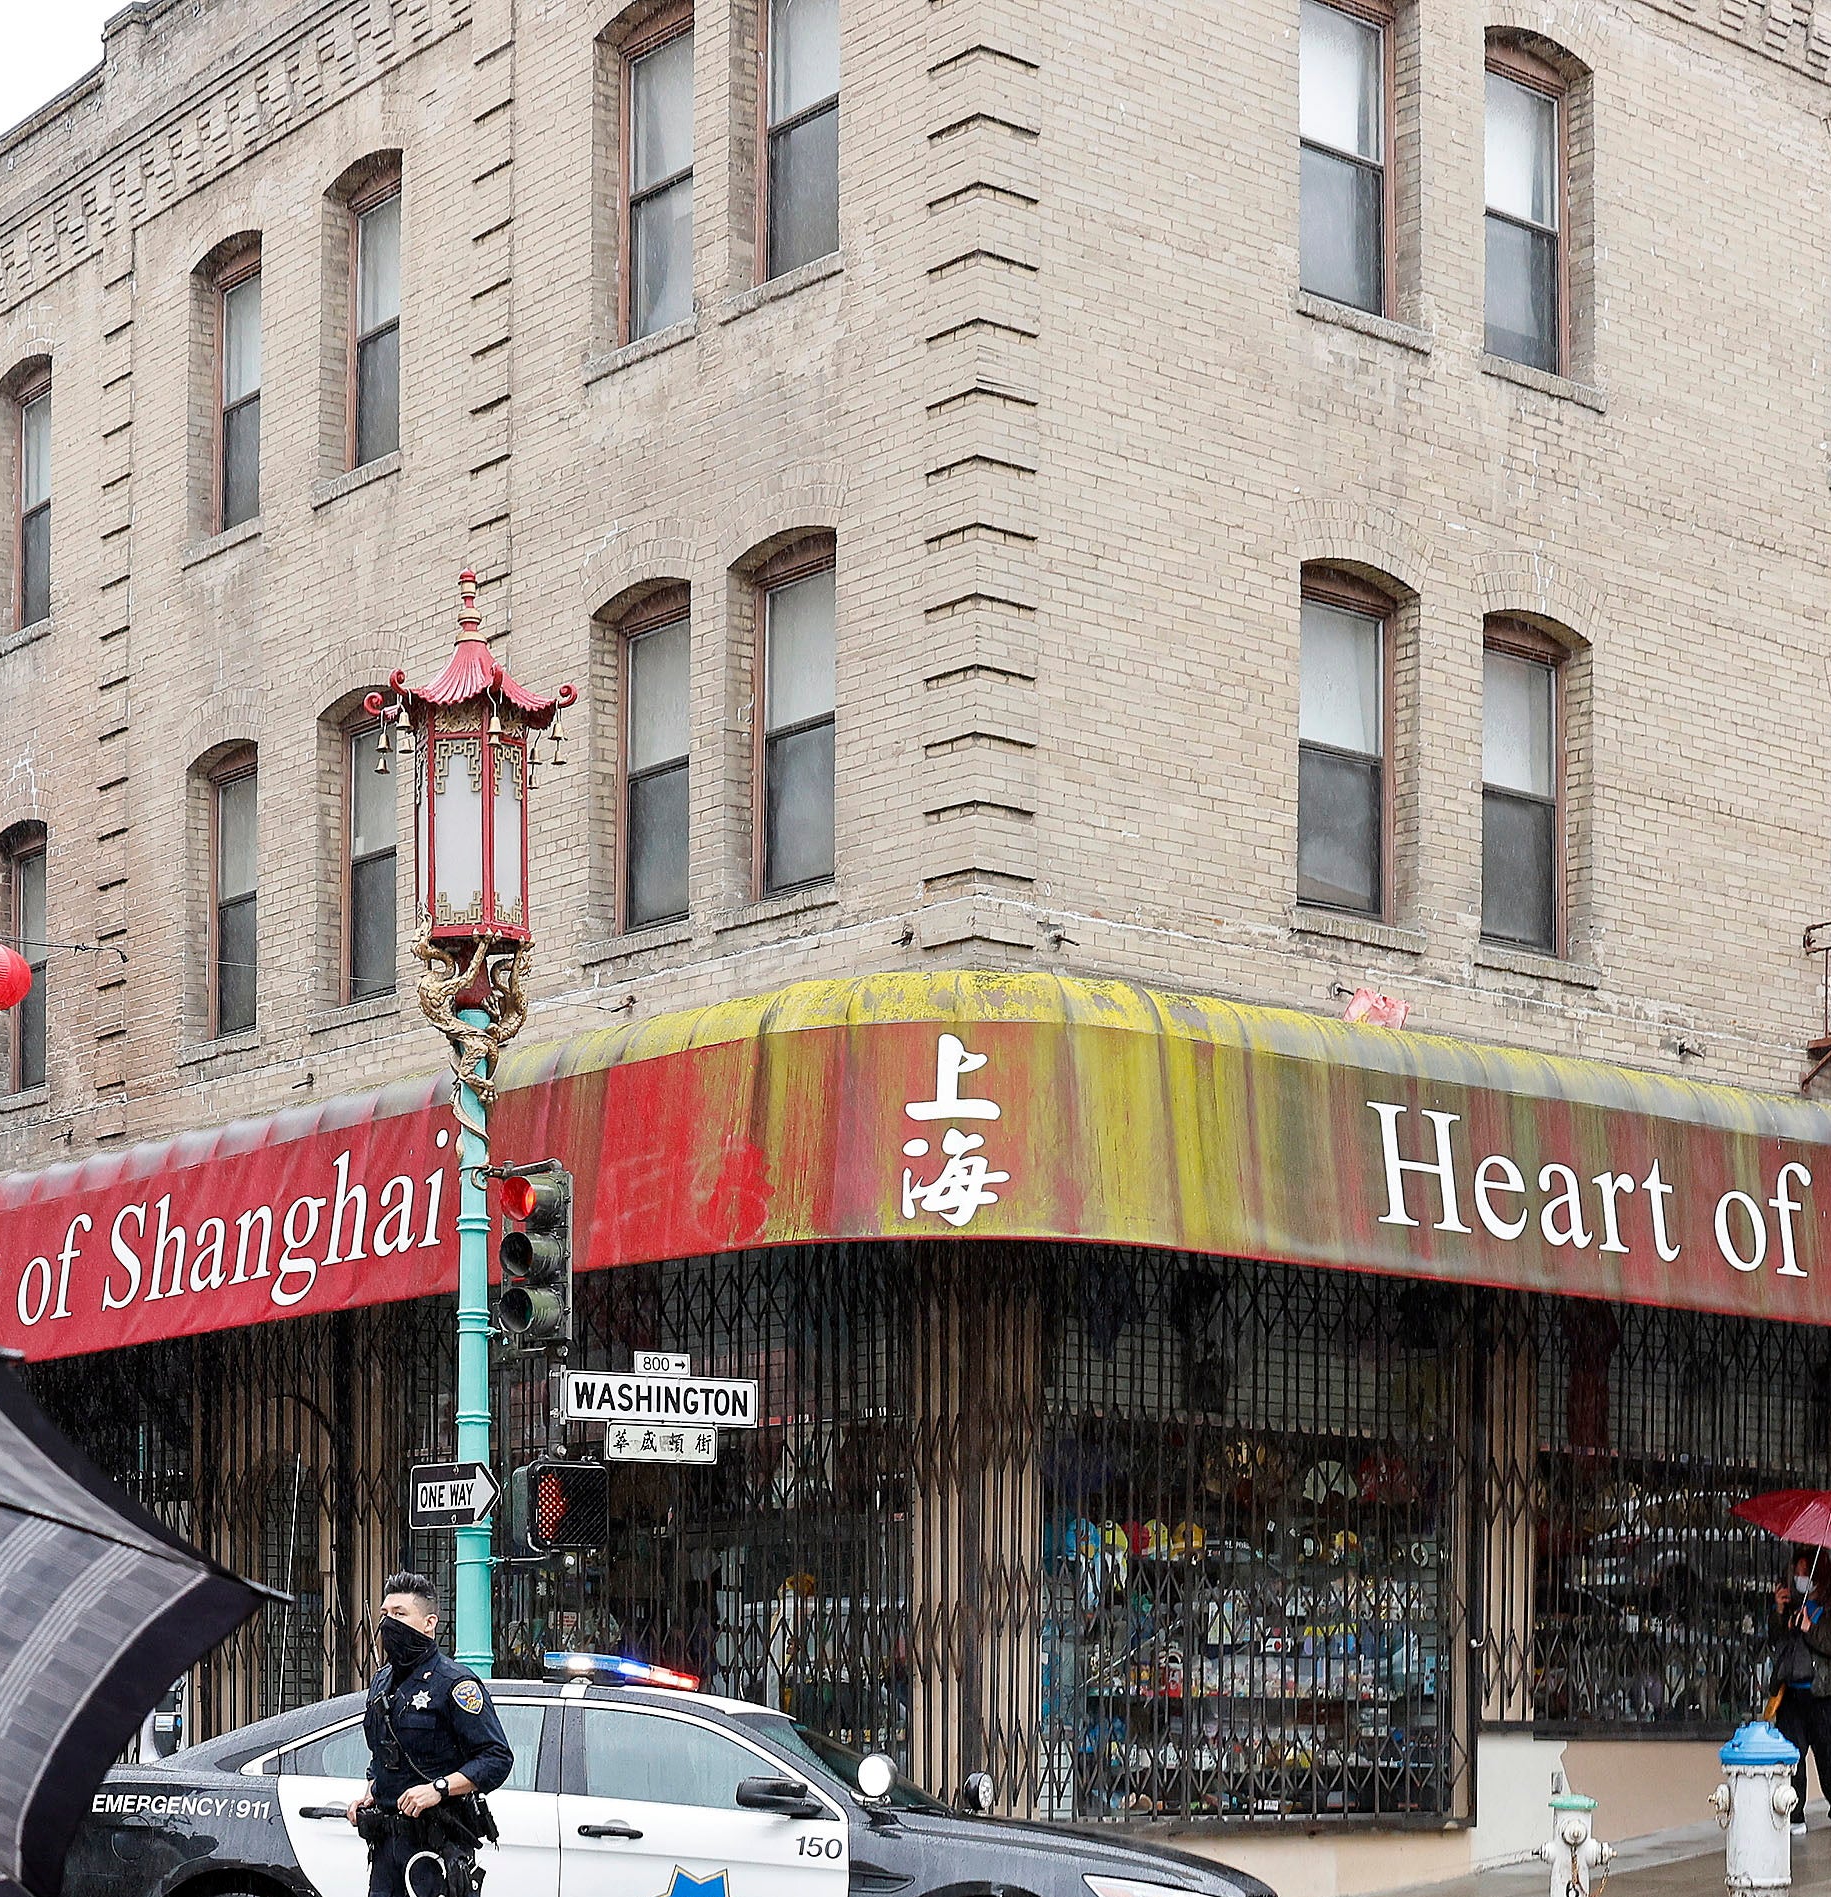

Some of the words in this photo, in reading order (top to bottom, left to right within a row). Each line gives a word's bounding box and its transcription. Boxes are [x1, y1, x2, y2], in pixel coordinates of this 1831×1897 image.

[902, 1033, 1011, 1227] 上海
[1366, 1100, 1681, 1262] Heart
[1713, 1161, 1811, 1278] of
[16, 1212, 92, 1327] of
[101, 1128, 451, 1311] Shanghai
[643, 1356, 670, 1372] 800
[574, 1381, 748, 1418] WASHINGTON
[419, 1484, 445, 1509] ONE
[449, 1481, 475, 1507] WAY
[91, 1794, 228, 1817] EMERGENCY
[235, 1799, 270, 1820] 911
[795, 1836, 843, 1860] 150
